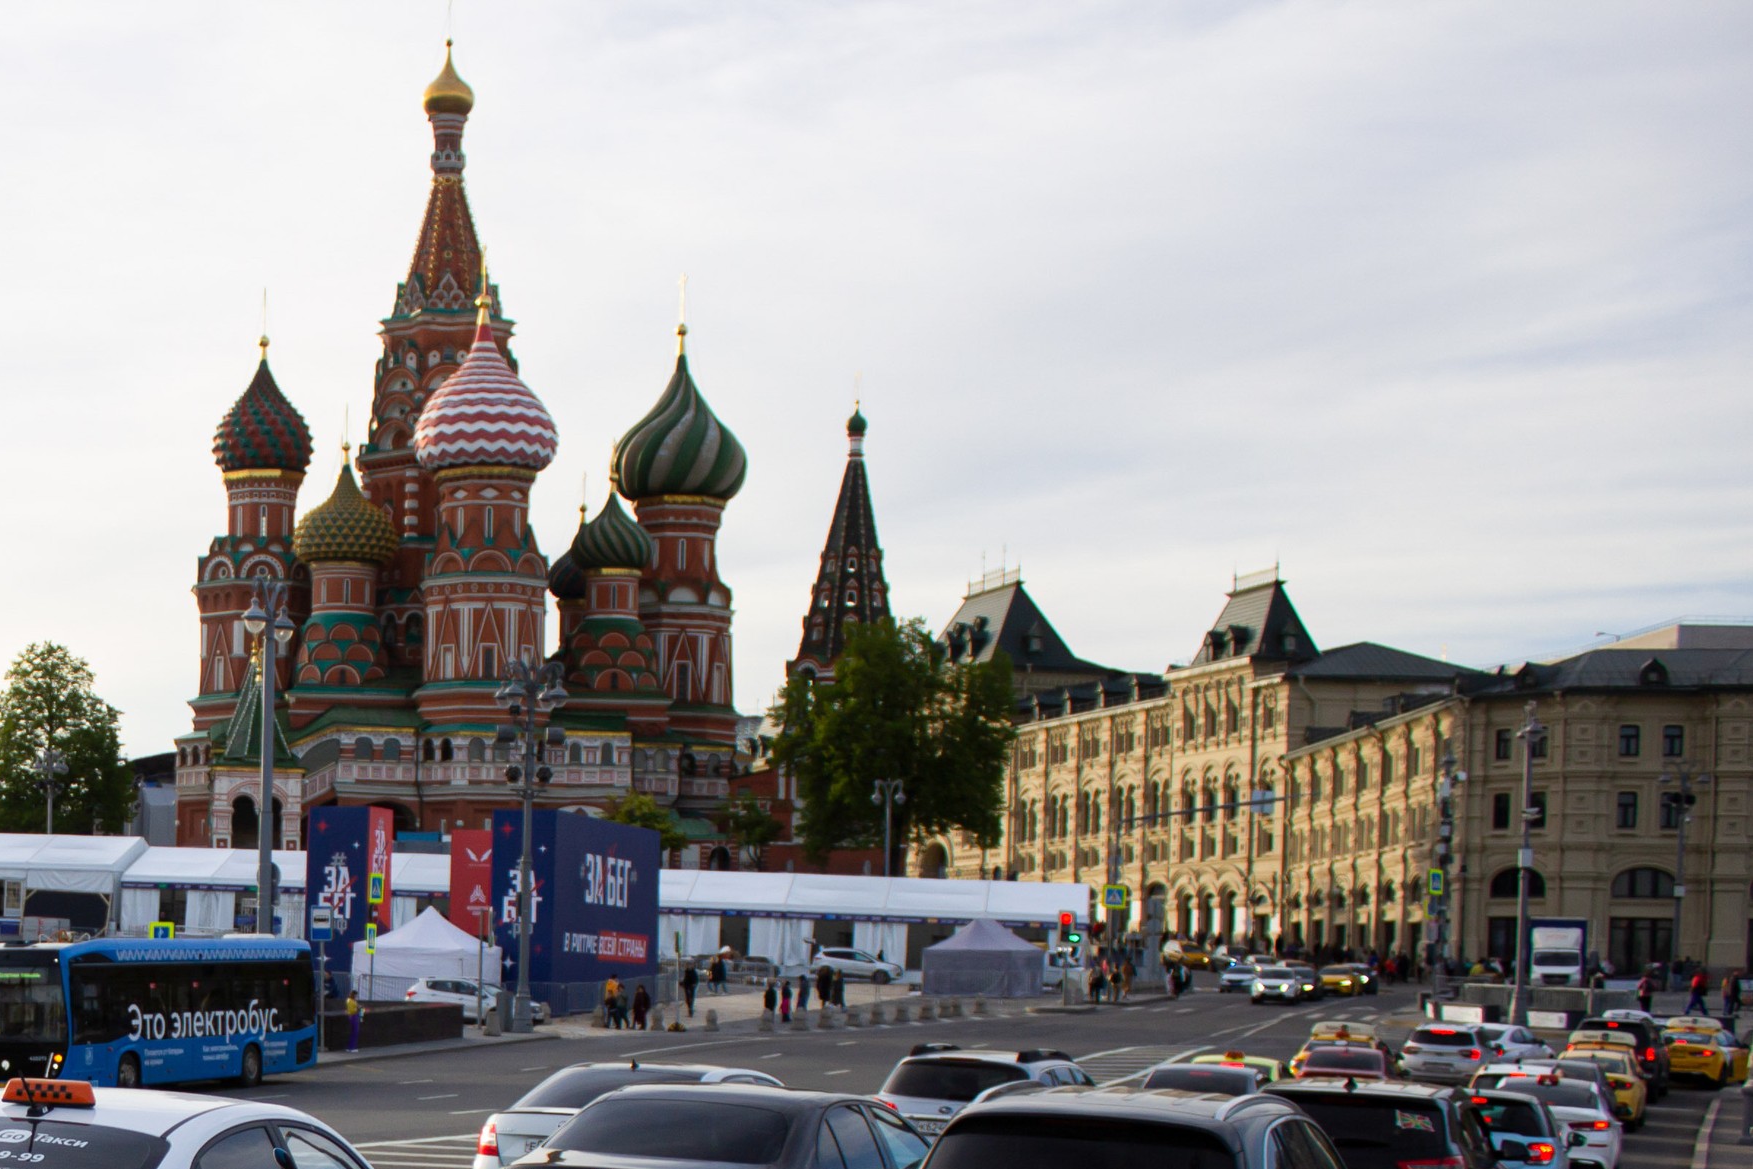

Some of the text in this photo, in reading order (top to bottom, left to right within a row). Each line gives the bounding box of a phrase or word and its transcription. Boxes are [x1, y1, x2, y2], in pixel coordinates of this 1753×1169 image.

[323, 866, 351, 893] ЗА
[563, 932, 571, 952] В
[598, 932, 617, 955] ВСЕЙ
[617, 937, 647, 958] СТРАНЫ
[127, 998, 284, 1043] Это электробус.
[34, 1133, 89, 1148] Такси
